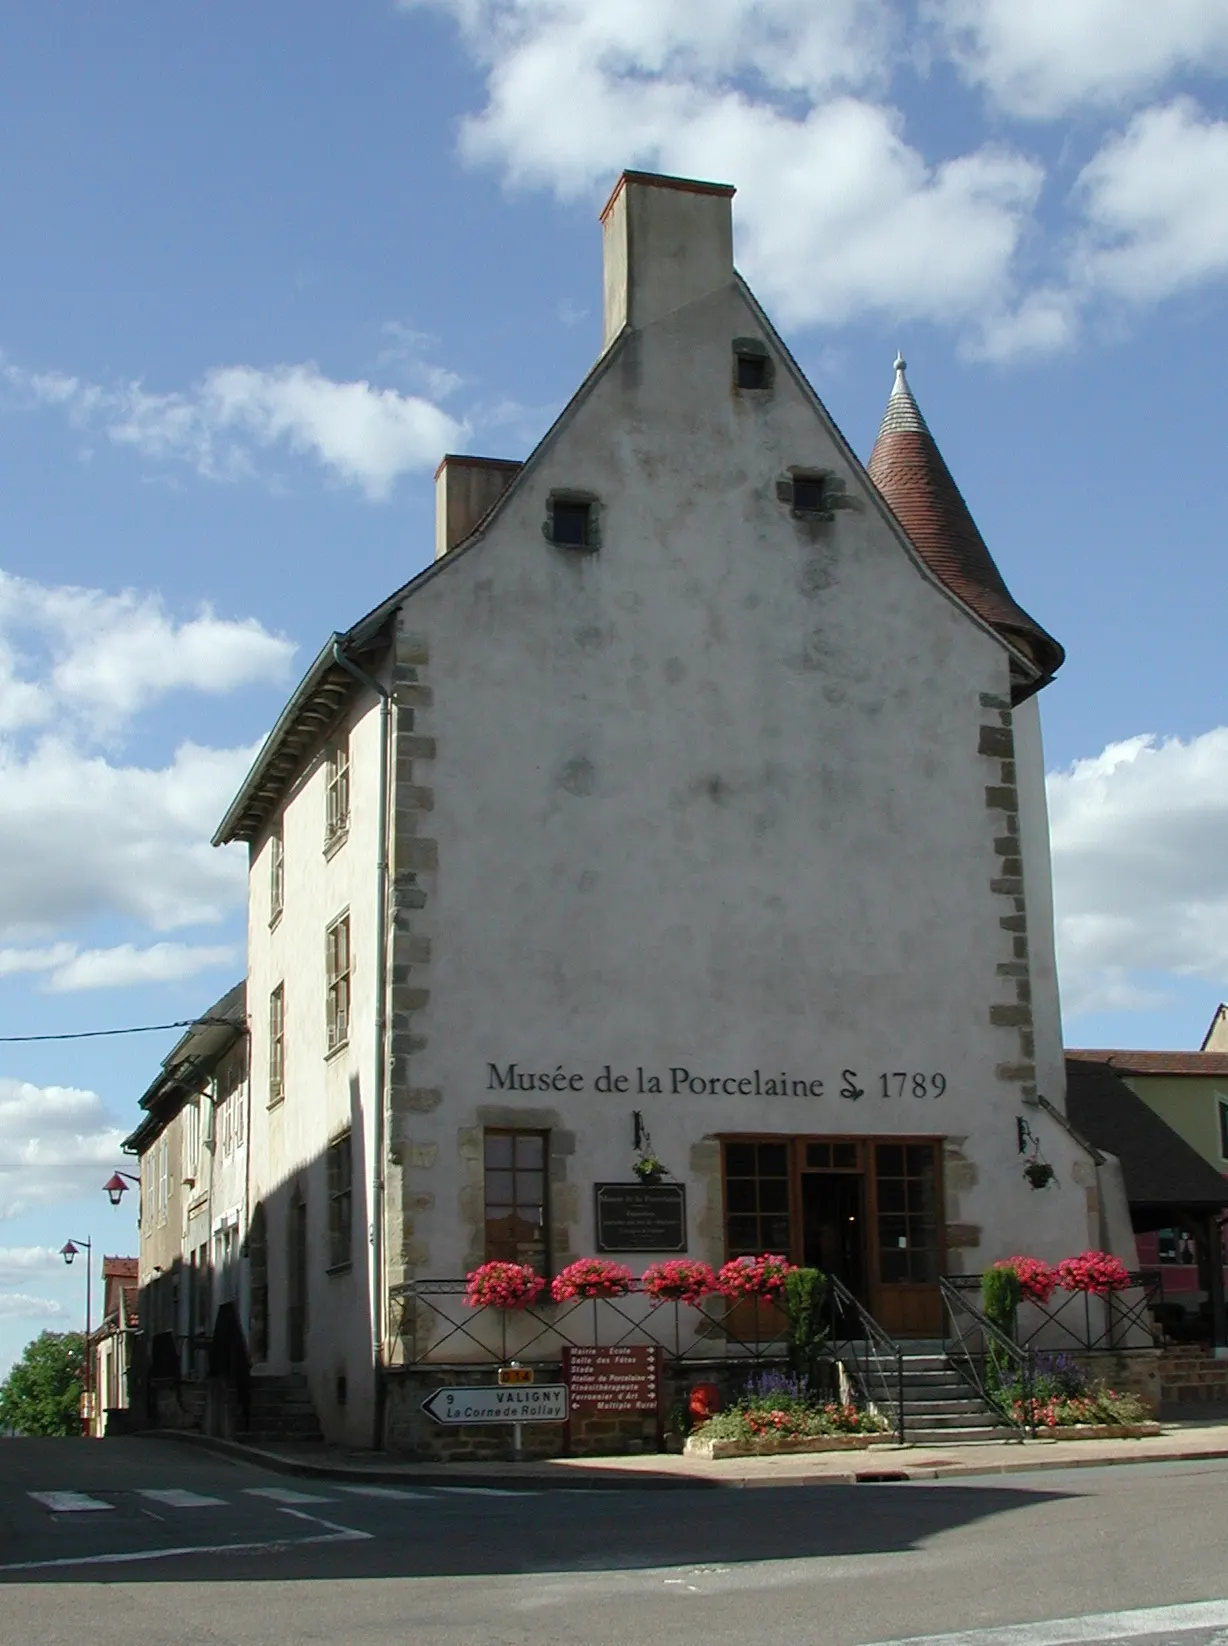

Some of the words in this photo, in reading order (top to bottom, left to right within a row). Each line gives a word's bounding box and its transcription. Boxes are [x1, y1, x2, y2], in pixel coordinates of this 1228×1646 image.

[486, 1062, 584, 1092] Musée
[595, 1065, 630, 1093] de
[636, 1066, 663, 1094] la
[668, 1067, 824, 1097] Porcelaine
[879, 1072, 947, 1099] 1789
[570, 1365, 594, 1373] Stade
[571, 1374, 596, 1382] Atelier
[609, 1374, 646, 1382] Porcelaine
[445, 1394, 455, 1405] 9
[496, 1391, 561, 1404] VALIGNY
[597, 1401, 632, 1410] Multiple
[636, 1401, 658, 1409] Rural
[447, 1408, 461, 1418] La
[465, 1407, 501, 1418] Corne
